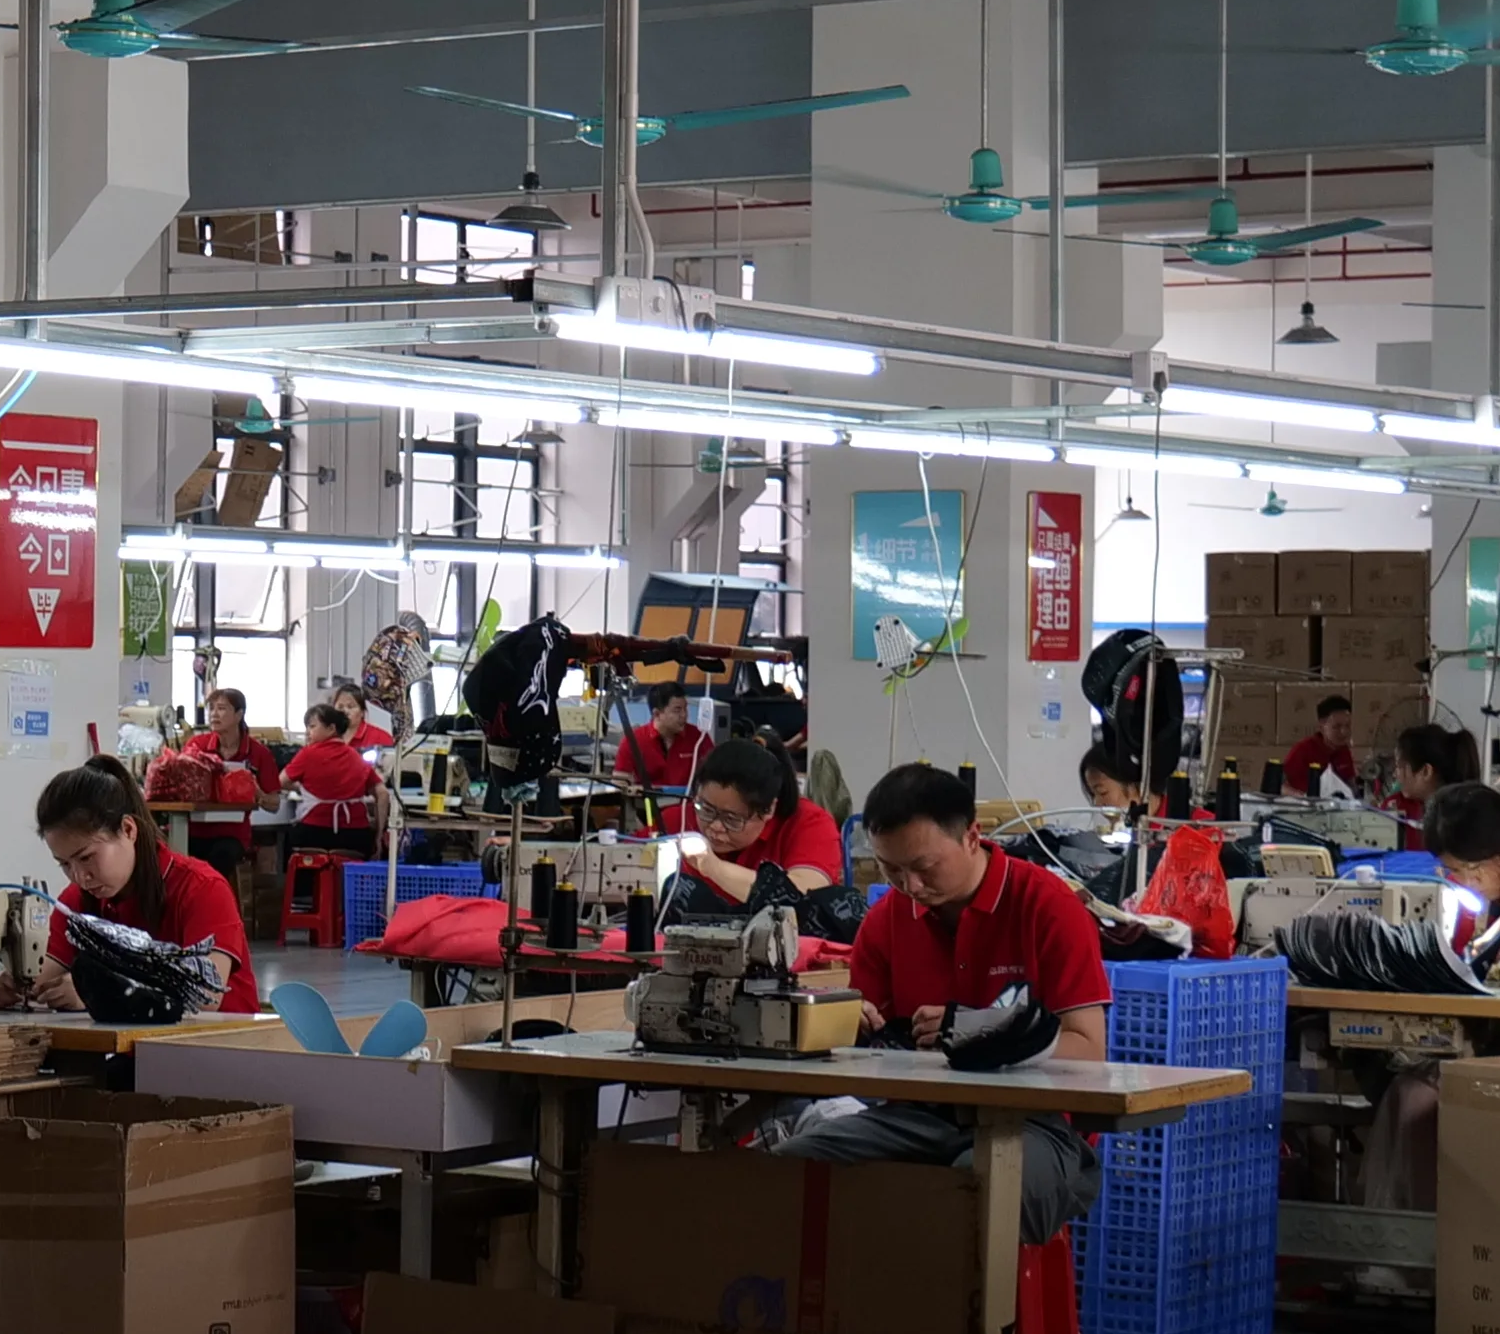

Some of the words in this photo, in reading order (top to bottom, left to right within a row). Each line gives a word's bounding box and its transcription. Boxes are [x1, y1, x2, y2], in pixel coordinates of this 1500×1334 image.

[19, 533, 69, 575] 今日
[36, 592, 52, 619] 毕
[1037, 592, 1070, 630] 理由
[1346, 897, 1382, 906] JUKI
[1338, 1024, 1383, 1035] JUKI
[1473, 1244, 1493, 1262] NW:
